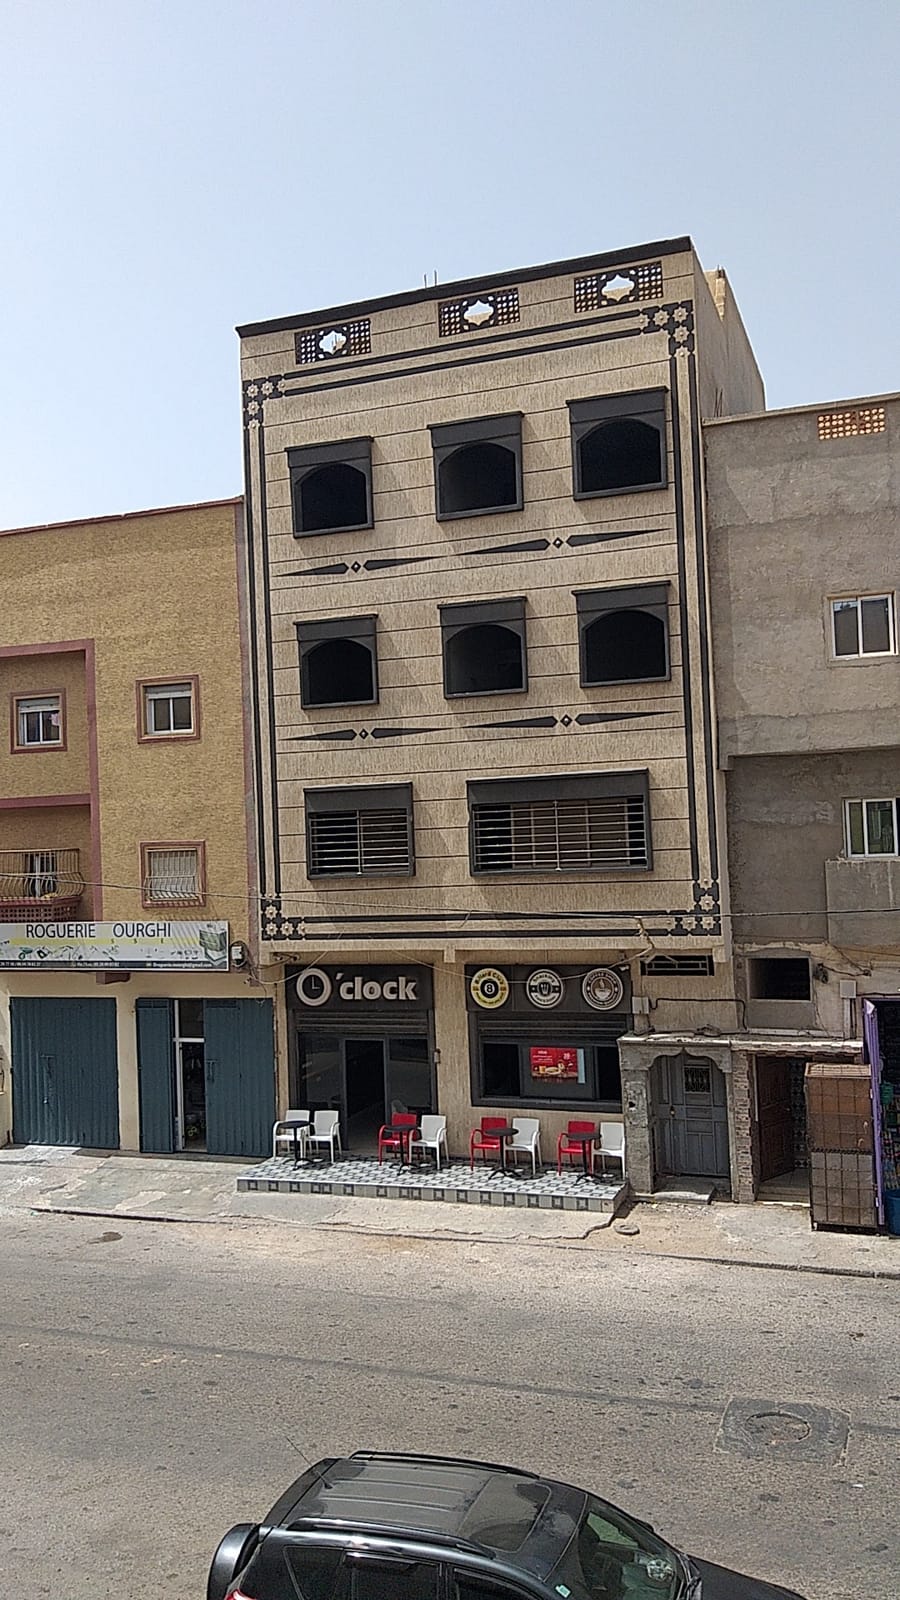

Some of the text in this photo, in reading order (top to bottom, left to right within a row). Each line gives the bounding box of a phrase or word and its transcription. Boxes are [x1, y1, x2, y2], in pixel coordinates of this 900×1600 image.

[26, 923, 171, 938] ROGUERIE OURGHI
[486, 984, 494, 993] 8
